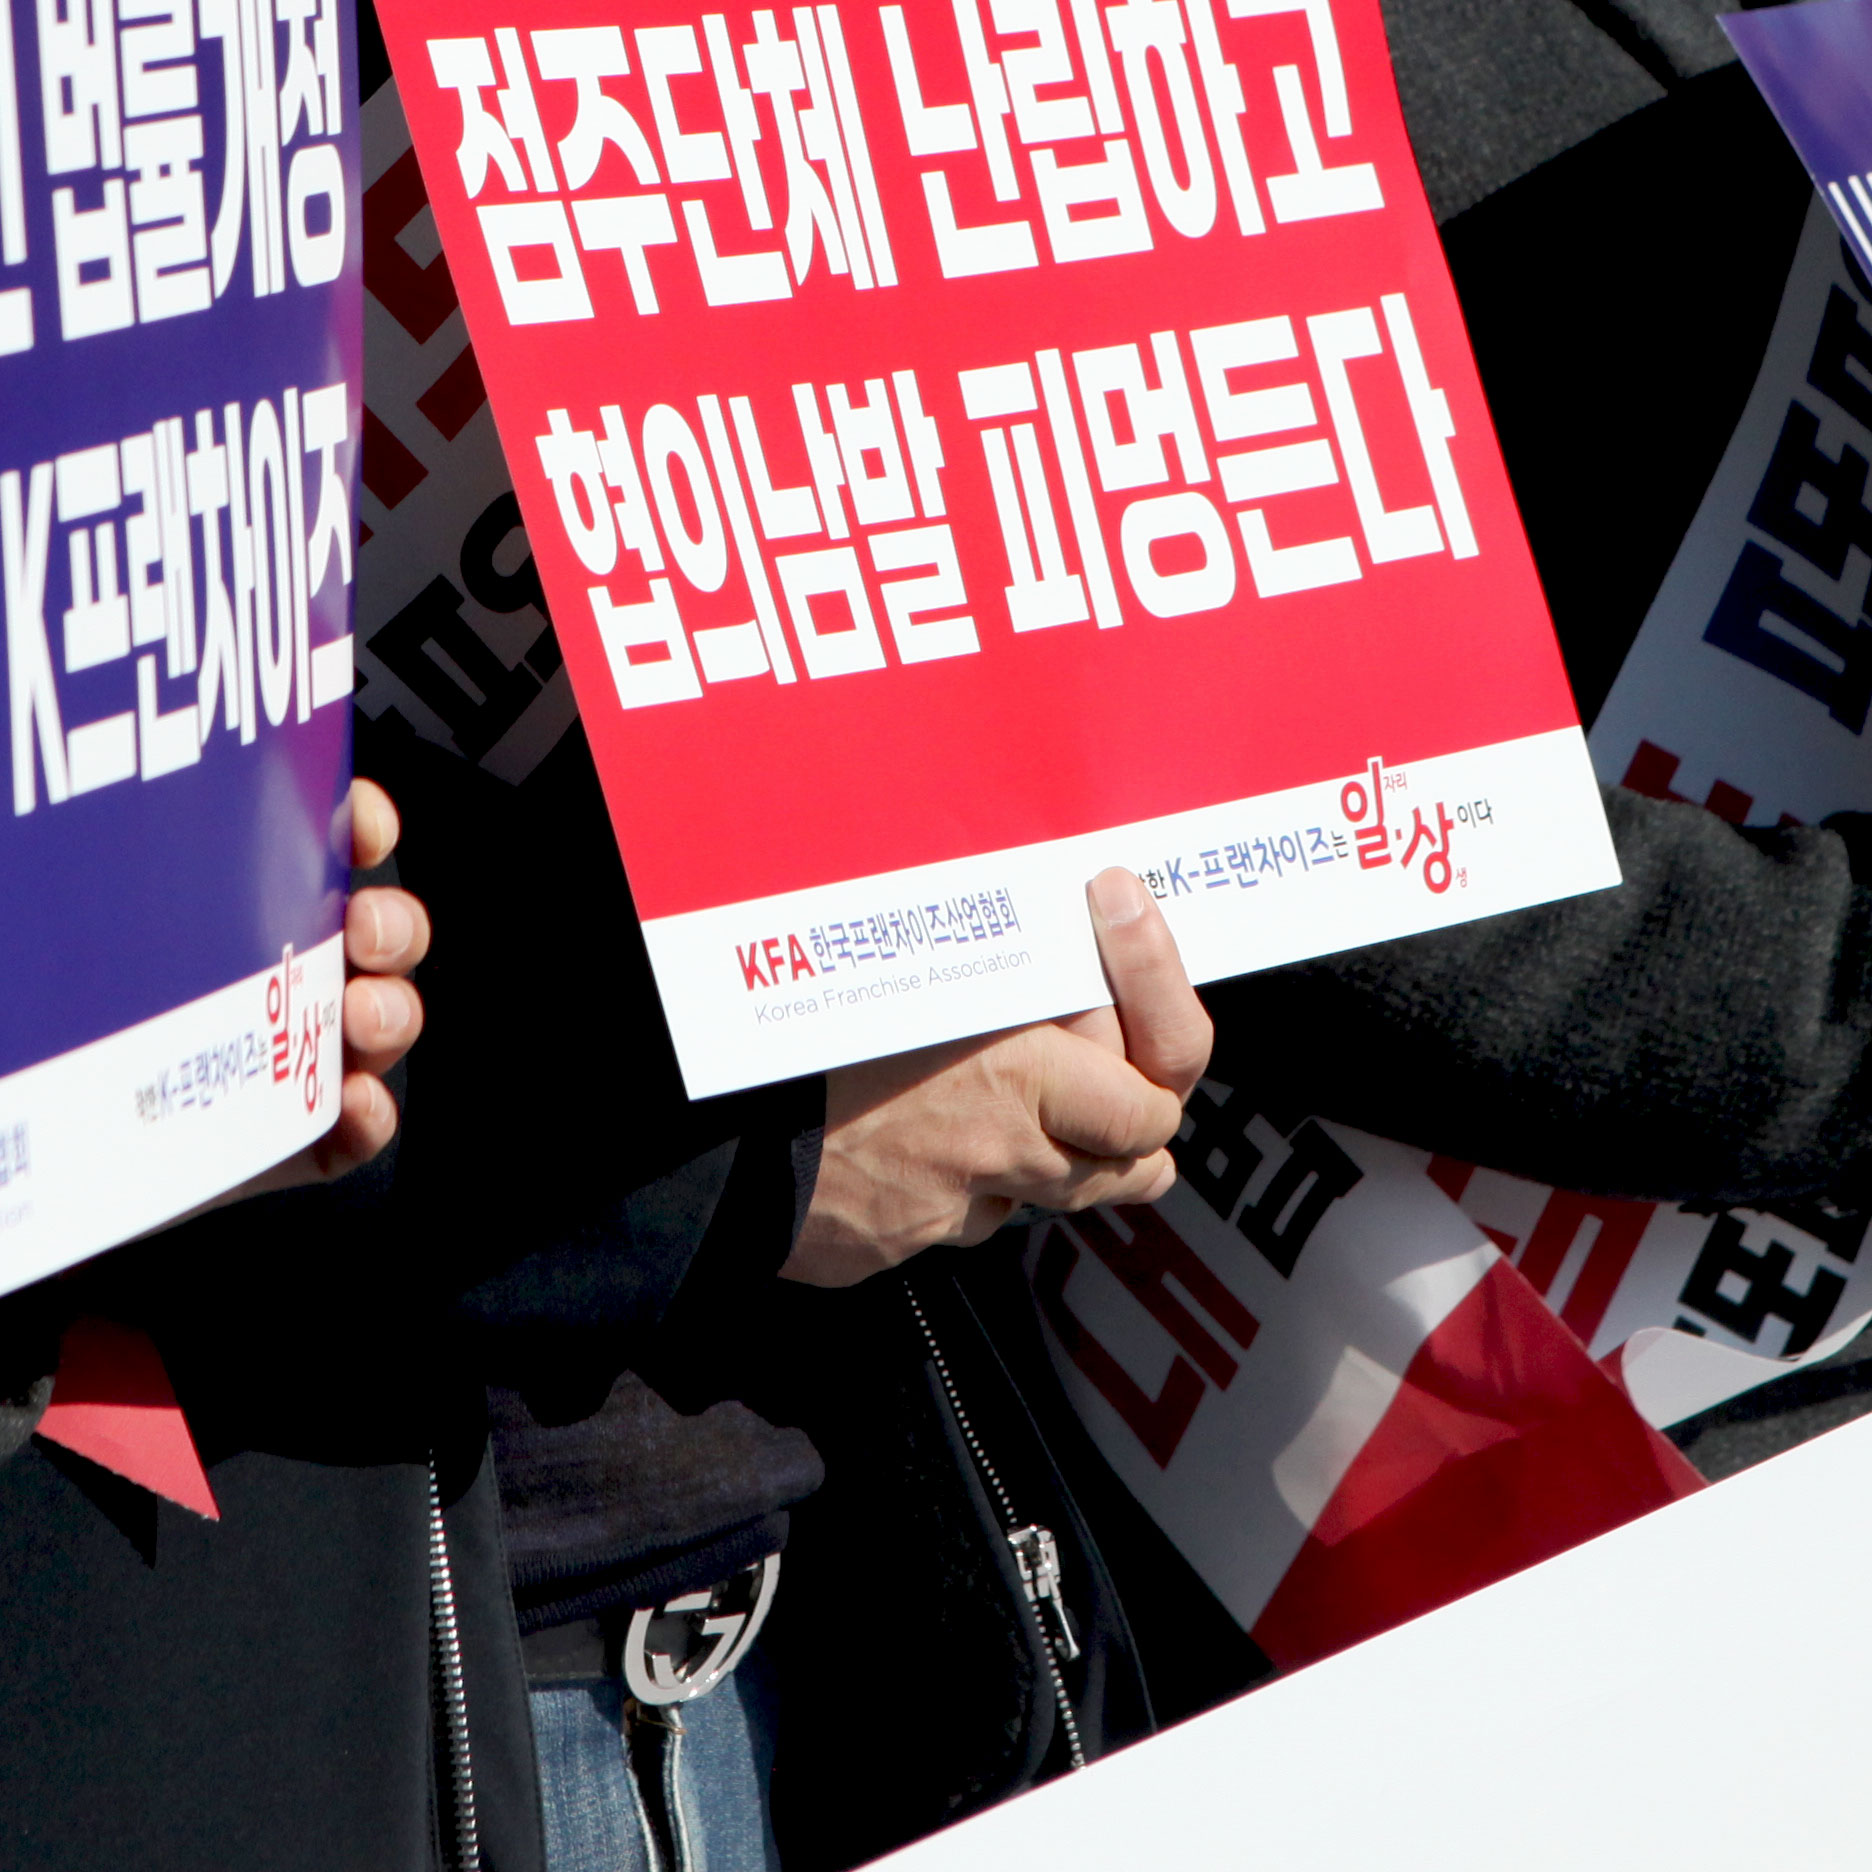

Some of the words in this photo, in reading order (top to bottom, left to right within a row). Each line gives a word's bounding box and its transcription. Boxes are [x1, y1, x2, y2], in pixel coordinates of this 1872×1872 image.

[426, 2, 899, 326] 점주단체
[534, 369, 981, 710] 협의남발
[958, 292, 1480, 633] 피멍든다
[735, 933, 816, 992] KFA
[754, 996, 819, 1025] Korea
[822, 969, 922, 1010] Franchise
[928, 947, 1032, 986] Association
